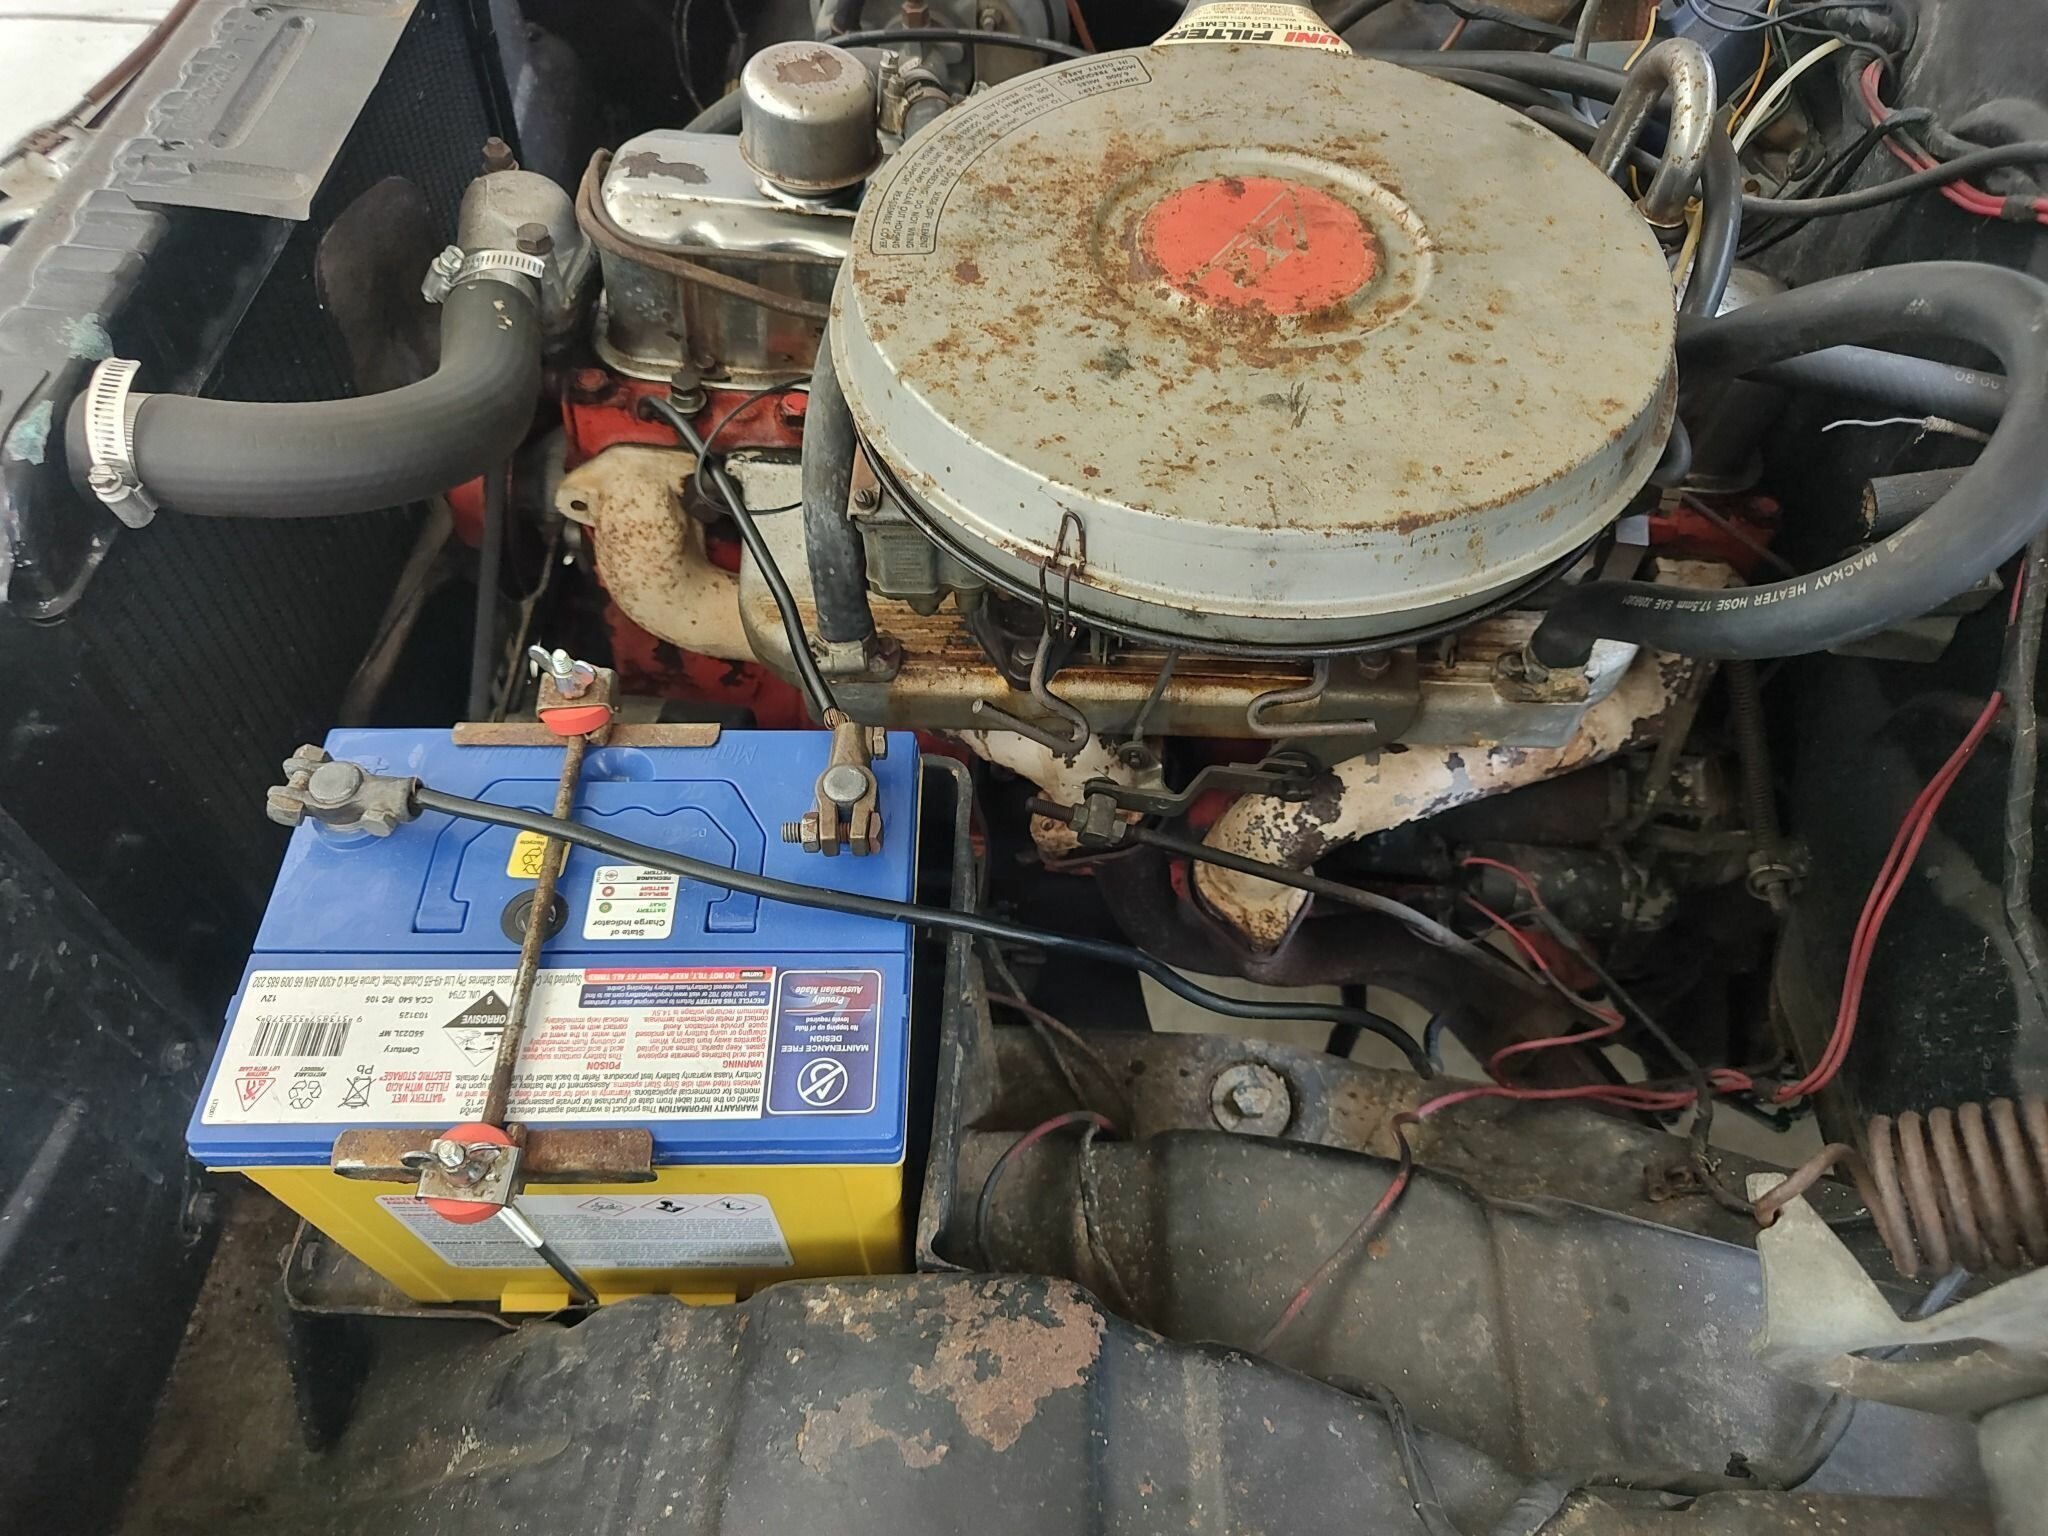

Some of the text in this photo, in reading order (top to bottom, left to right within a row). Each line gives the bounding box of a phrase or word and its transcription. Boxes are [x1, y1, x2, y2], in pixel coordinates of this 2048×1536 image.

[1251, 23, 1301, 31] FILTER
[1164, 29, 1340, 46] UNI FILTER
[1088, 62, 1113, 72] DUSTY
[1058, 64, 1136, 86] MORE FREQUENTLY
[1077, 78, 1099, 87] MILES
[1078, 77, 1139, 95] SERVICE EVERY
[1024, 104, 1048, 116] CLEAN
[898, 206, 907, 218] OUT
[910, 212, 919, 224] NOT
[920, 222, 930, 248] ELEMENT
[1654, 551, 1878, 612] MACKAY HEATER HOSE 17.5mm SAE
[634, 918, 666, 926] Charge
[253, 977, 267, 988] 232
[267, 977, 280, 988] 685
[281, 977, 294, 987] 009
[295, 977, 304, 987] 66
[304, 977, 319, 987] ABN
[320, 976, 336, 987] 4300
[344, 976, 359, 987] Park
[361, 976, 381, 987] Carole
[404, 976, 423, 987] Cobalt
[445, 976, 455, 986] Ltd
[457, 974, 467, 986] Pty
[469, 976, 496, 986] Batteries
[555, 975, 582, 986] Supplied
[448, 991, 466, 999] 2794
[795, 986, 863, 995] Australian Made
[487, 996, 493, 1004] 8
[812, 996, 844, 1004] Proudly
[461, 1015, 506, 1024] ORROSIVE
[827, 1023, 849, 1031] topping
[384, 1045, 420, 1054] Century
[806, 1044, 869, 1052] MAINTENANCE
[586, 1062, 621, 1070] POISON
[722, 1060, 763, 1068] WARNING
[356, 1065, 375, 1074] Pb
[418, 1071, 452, 1080] ELECTRIC
[603, 1072, 639, 1080] procedure.
[656, 1072, 680, 1080] battery
[385, 1082, 449, 1092] FILLED WITH ACID
[546, 1082, 557, 1090] the
[558, 1082, 566, 1090] of
[568, 1081, 610, 1089] Assessment
[663, 1079, 679, 1088] Stop
[633, 1088, 678, 1096] applications.
[517, 1097, 554, 1105] passenger
[557, 1097, 581, 1106] private
[595, 1097, 627, 1105] purchase
[629, 1097, 636, 1105] of
[638, 1097, 654, 1105] date
[460, 1107, 483, 1116] period
[538, 1105, 564, 1114] against
[566, 1106, 602, 1114] warranted
[613, 1105, 641, 1114] product
[659, 1105, 712, 1113] INFORMATION
[714, 1104, 758, 1112] WARRANTY
